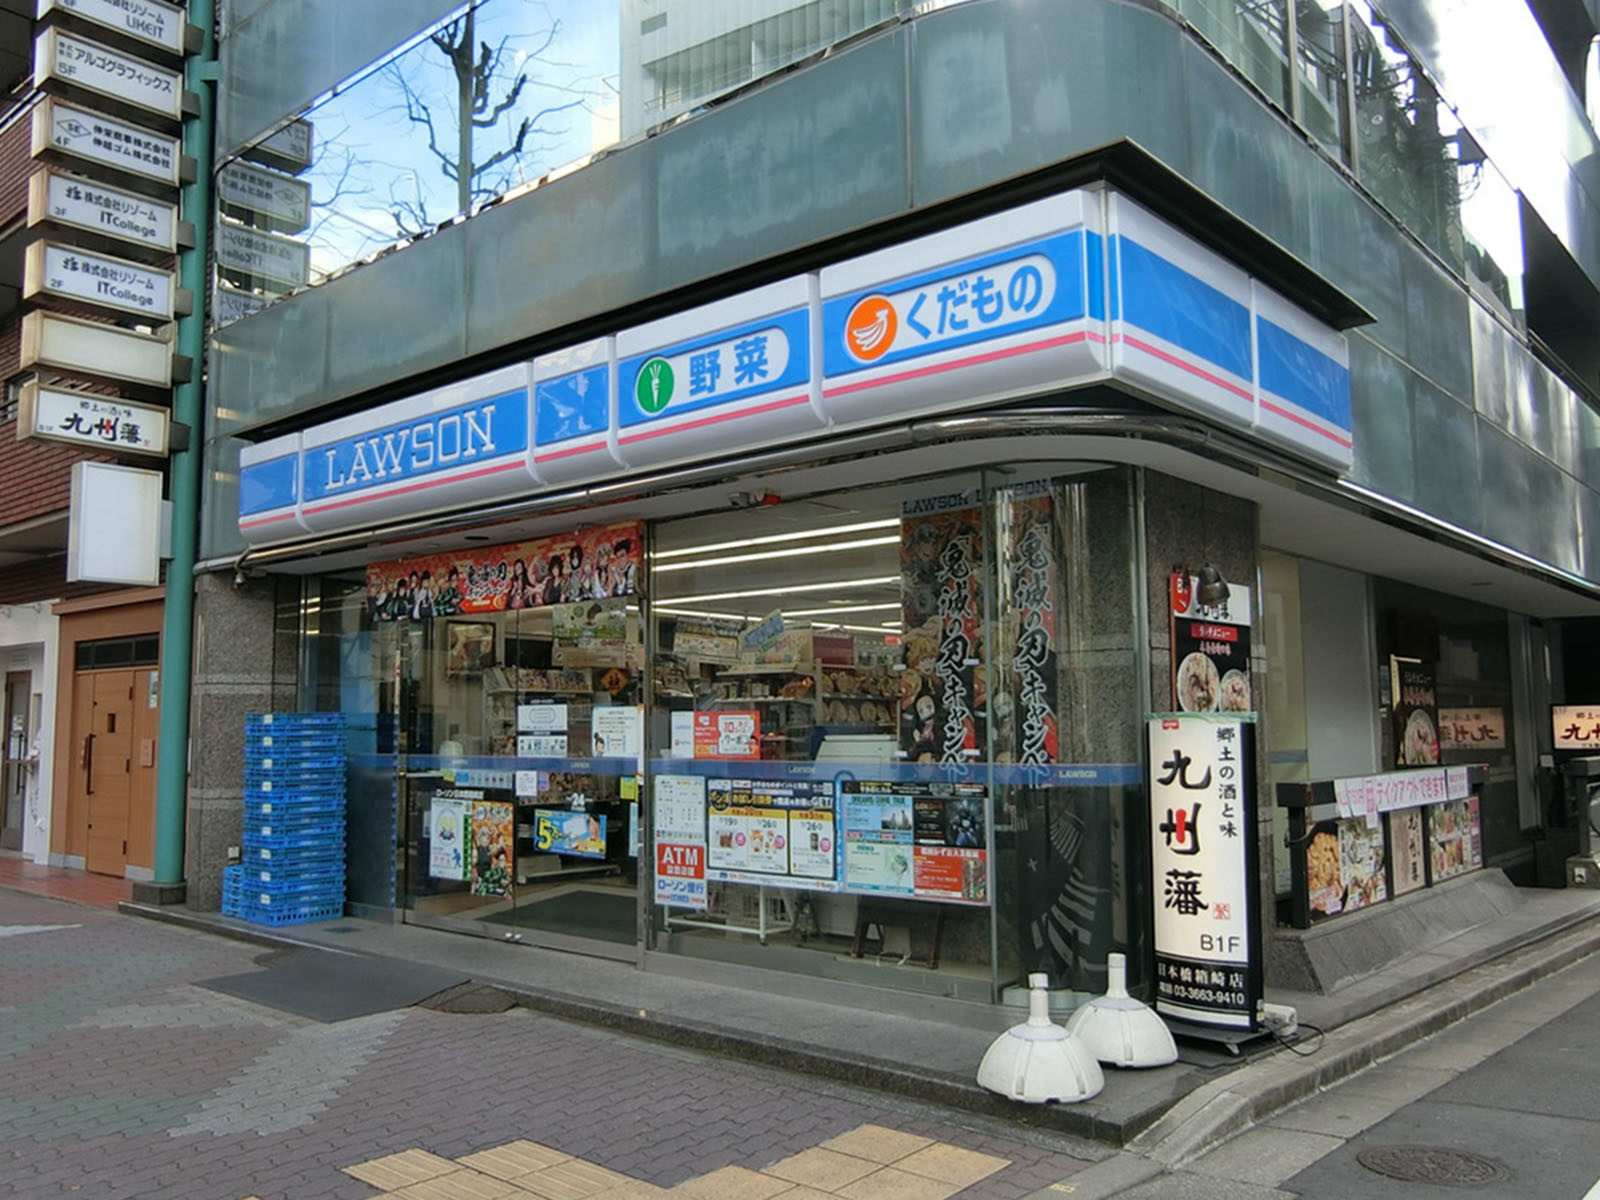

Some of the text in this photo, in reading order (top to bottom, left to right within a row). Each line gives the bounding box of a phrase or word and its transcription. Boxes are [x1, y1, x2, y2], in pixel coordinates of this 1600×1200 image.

[59, 62, 77, 76] 5F
[55, 134, 70, 147] 4F
[50, 278, 64, 289] 2F
[81, 262, 154, 290] 株式会社リゾーム
[97, 281, 154, 306] ITCollege
[904, 264, 1043, 339] くだもの
[688, 336, 769, 397] 野菜
[59, 412, 142, 443] 九州藩
[325, 404, 496, 492] LAWSON
[1216, 726, 1238, 838] 郷土の酒と味
[1156, 748, 1212, 916] 九州藩
[663, 847, 698, 866] ATM
[1200, 933, 1240, 953] B1F
[1157, 962, 1244, 988] 日本橋箱崎店
[1174, 984, 1245, 1005] 03-3663-9410
